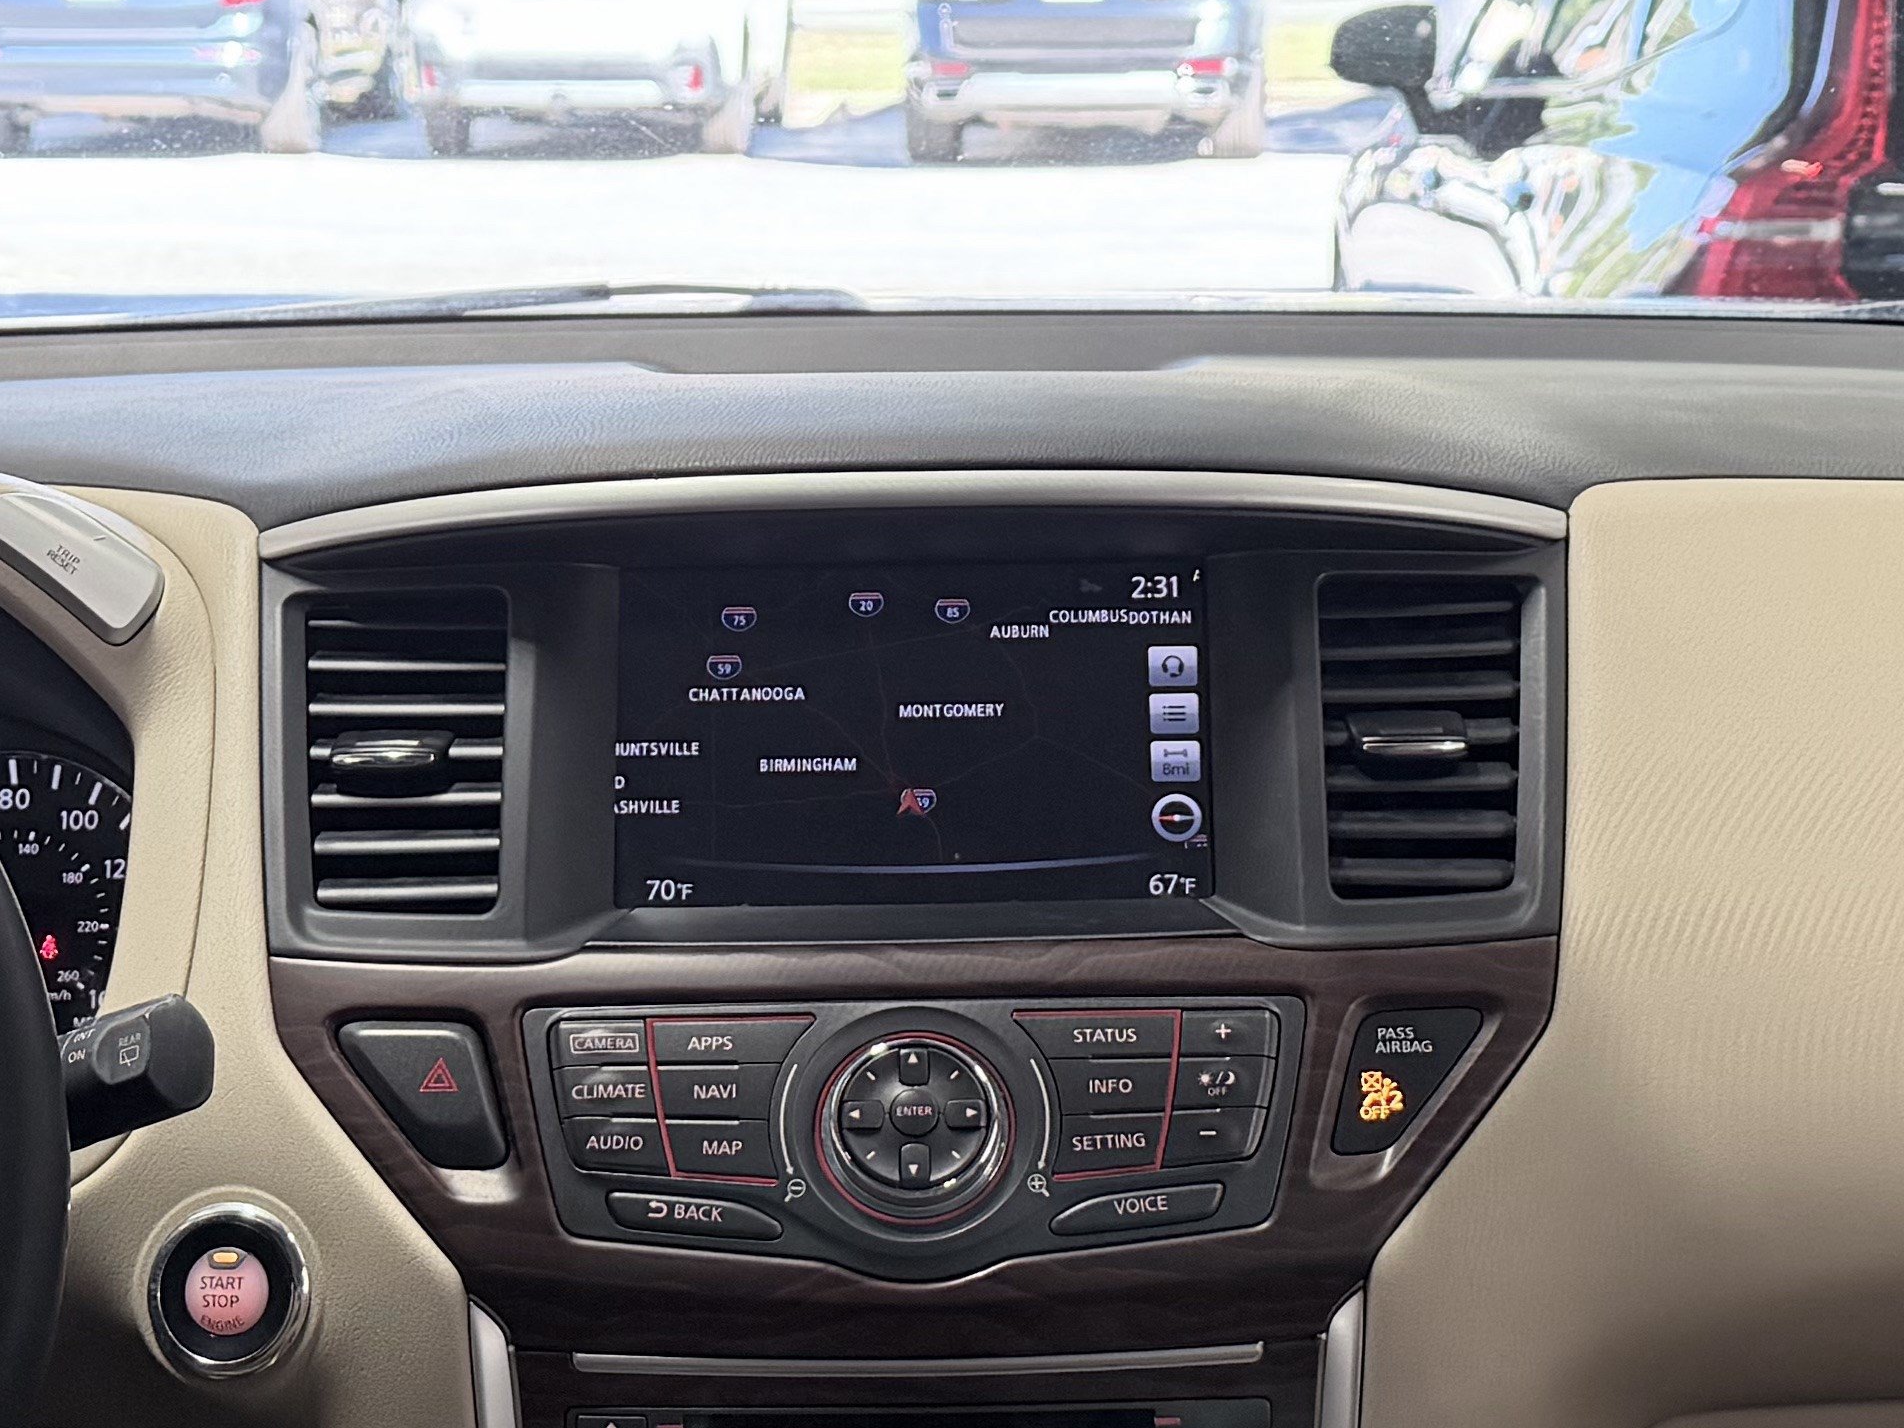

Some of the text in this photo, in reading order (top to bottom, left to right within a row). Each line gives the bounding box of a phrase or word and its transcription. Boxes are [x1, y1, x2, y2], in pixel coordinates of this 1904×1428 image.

[46, 549, 79, 575] RESET
[57, 544, 81, 565] TRIP
[1131, 575, 1178, 599] 2:31
[859, 599, 874, 612] 20
[946, 606, 961, 619] 85
[733, 613, 747, 627] 75
[1049, 609, 1128, 625] COLUMBUS
[1129, 610, 1192, 625] DOTHAN
[990, 625, 1050, 639] AUBURN
[717, 662, 732, 676] 59
[688, 687, 806, 702] CHATTANOOGA
[898, 702, 1005, 719] MONTGOMERY
[759, 757, 858, 773] BIRMINGHAM
[60, 810, 99, 830] 100
[18, 843, 40, 855] 140
[104, 858, 127, 880] 12
[62, 872, 84, 884] 180
[77, 921, 99, 933] 220
[57, 970, 80, 983] 260
[118, 1032, 142, 1047] REAR
[1072, 1028, 1138, 1044] STATUS
[1377, 1027, 1415, 1040] PASS
[573, 1036, 637, 1052] CAMERA
[687, 1035, 733, 1052] APPS
[1375, 1039, 1434, 1054] AIRBAG
[68, 1049, 86, 1064] ON
[571, 1084, 646, 1100] CLIMATE
[693, 1084, 738, 1100] NAVI
[1088, 1078, 1133, 1094] INFO
[1207, 1086, 1227, 1097] OFF
[896, 1105, 933, 1117] ENTER
[1360, 1106, 1389, 1121] OFF
[585, 1134, 644, 1151] AUDIO
[701, 1139, 744, 1156] MAP
[1071, 1132, 1147, 1151] SETTING
[1113, 1195, 1169, 1215] VOICE
[673, 1204, 724, 1224] BACK
[199, 1275, 245, 1291] START
[202, 1294, 240, 1309] STOP
[199, 1314, 246, 1333] ENGINE
